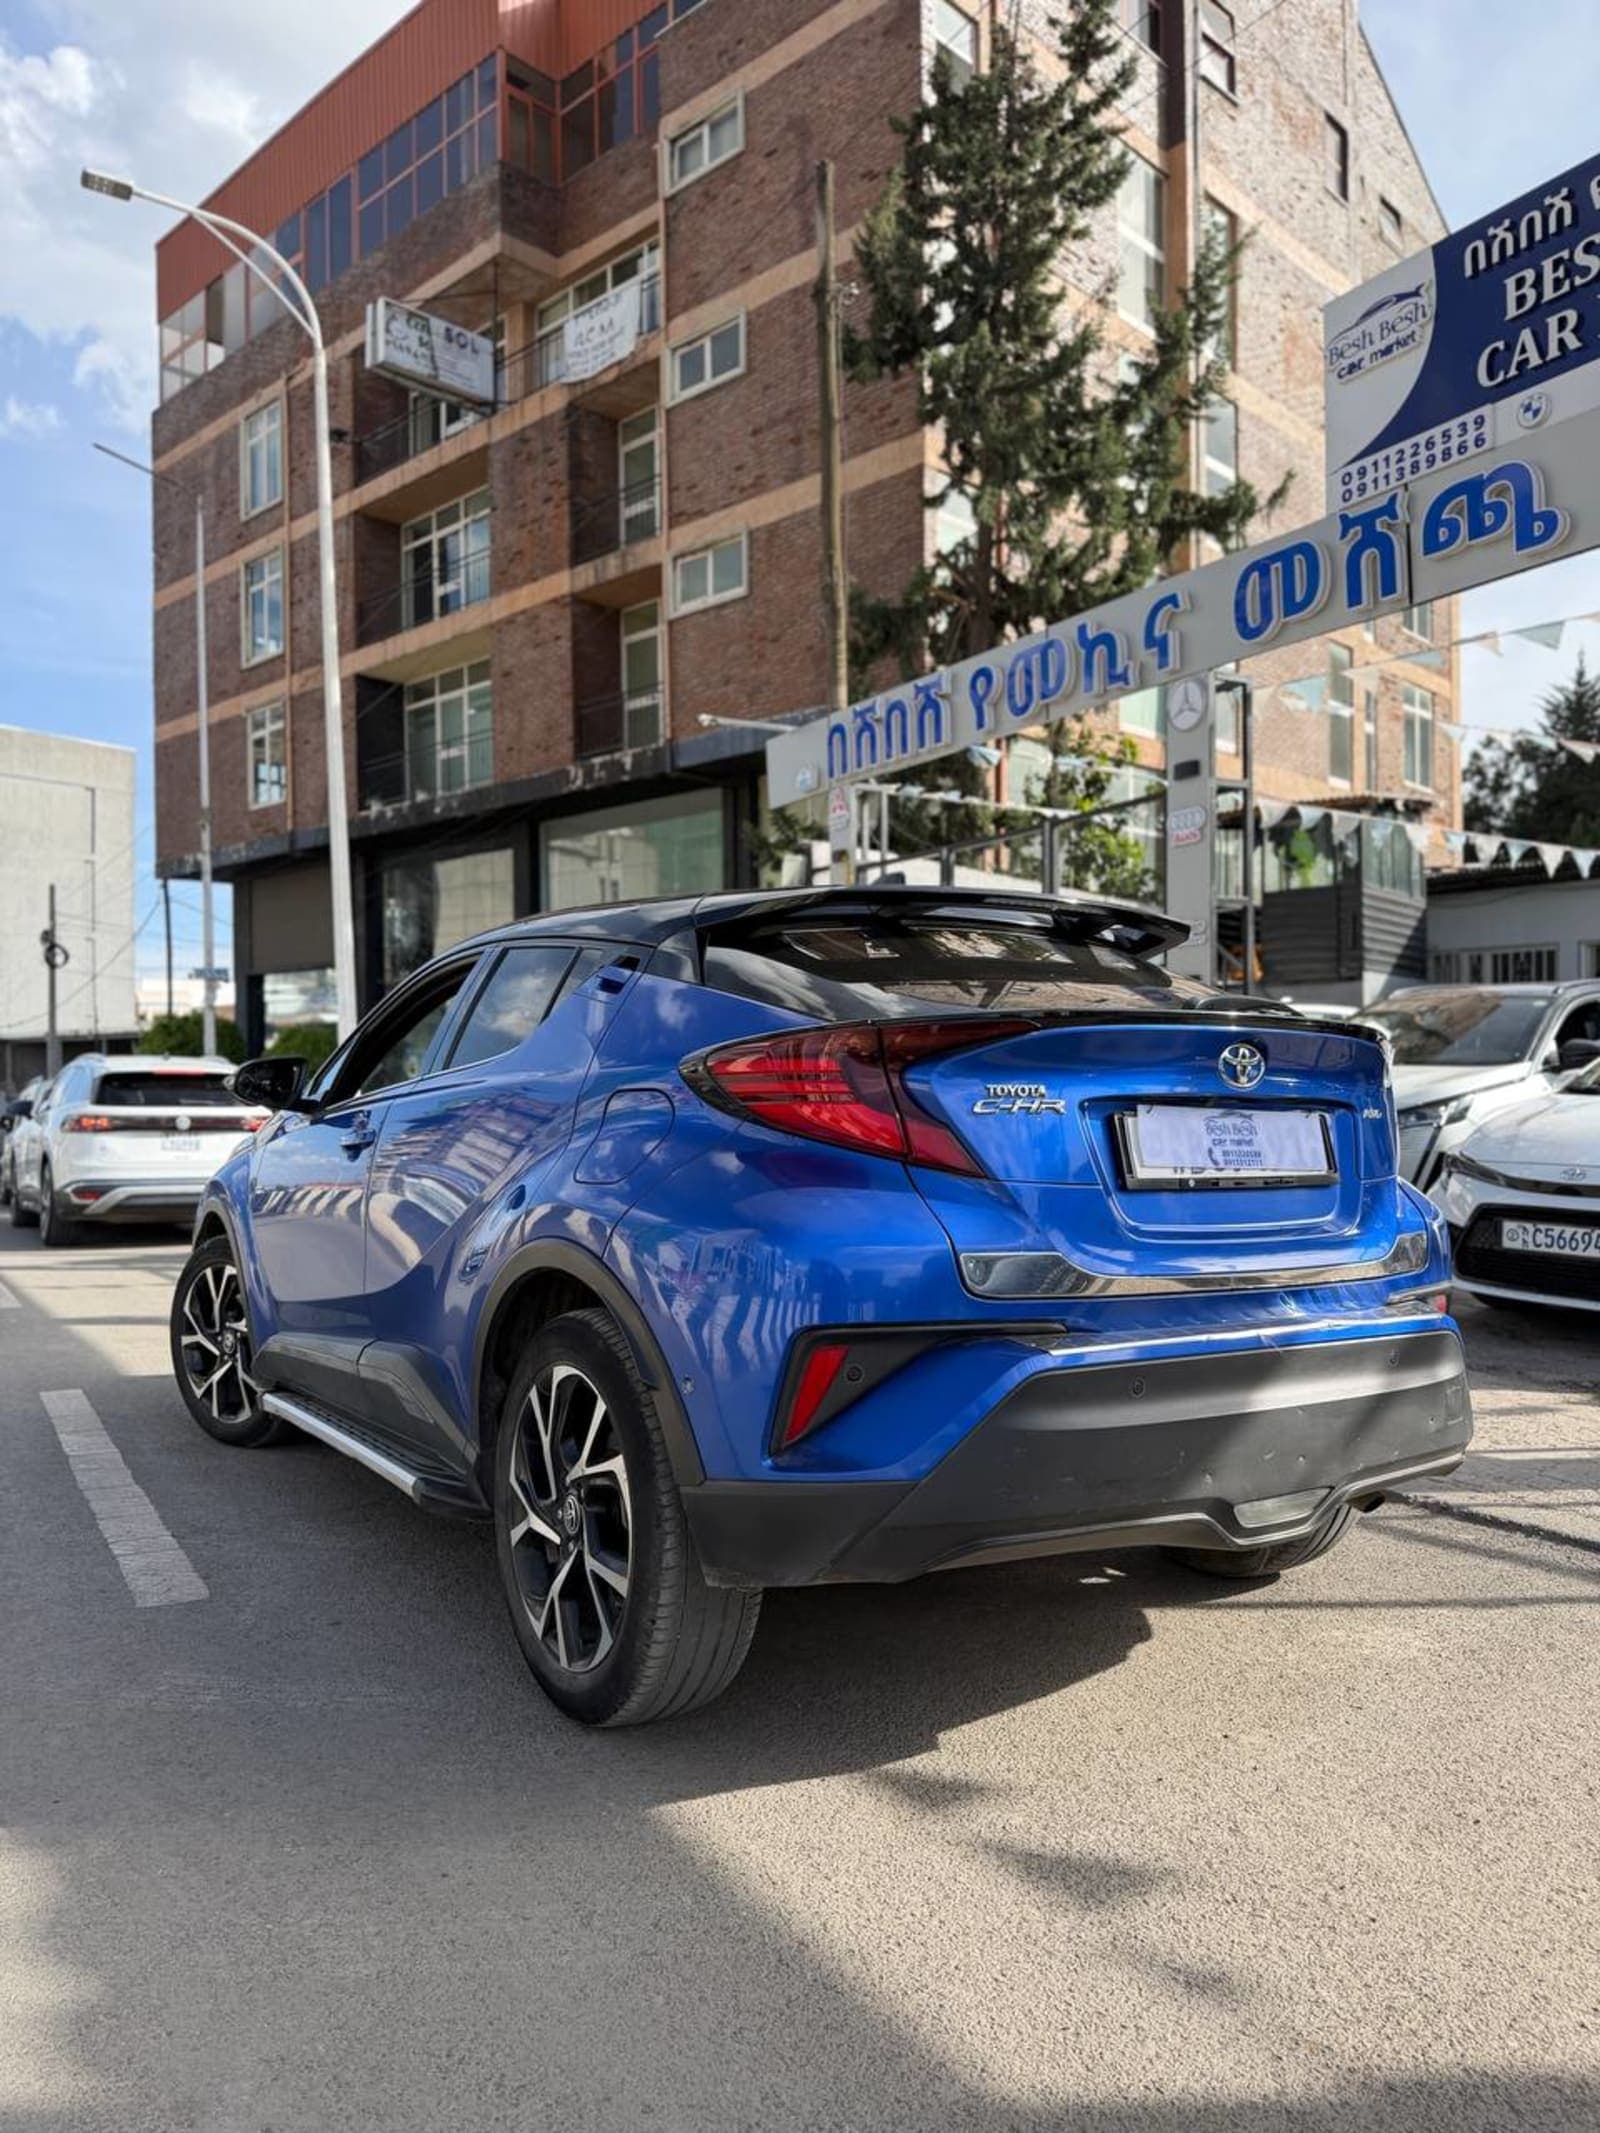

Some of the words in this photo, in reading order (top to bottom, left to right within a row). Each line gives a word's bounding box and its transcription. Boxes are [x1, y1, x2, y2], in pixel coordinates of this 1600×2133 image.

[1464, 186, 1573, 279] በሽበሽ
[1328, 329, 1374, 366] Besh
[1379, 301, 1428, 341] Besh
[1336, 358, 1366, 380] car
[1369, 330, 1417, 365] market
[1476, 308, 1583, 388] CAR
[1341, 414, 1486, 487] 0911226539
[1341, 432, 1487, 503] 0911389866
[827, 675, 943, 779] በሽበሽ
[969, 592, 1182, 731] የመኪና
[1233, 460, 1561, 641] መሸጫ
[973, 1099, 1067, 1115] C-HR
[986, 1084, 1046, 1098] TOYOTA
